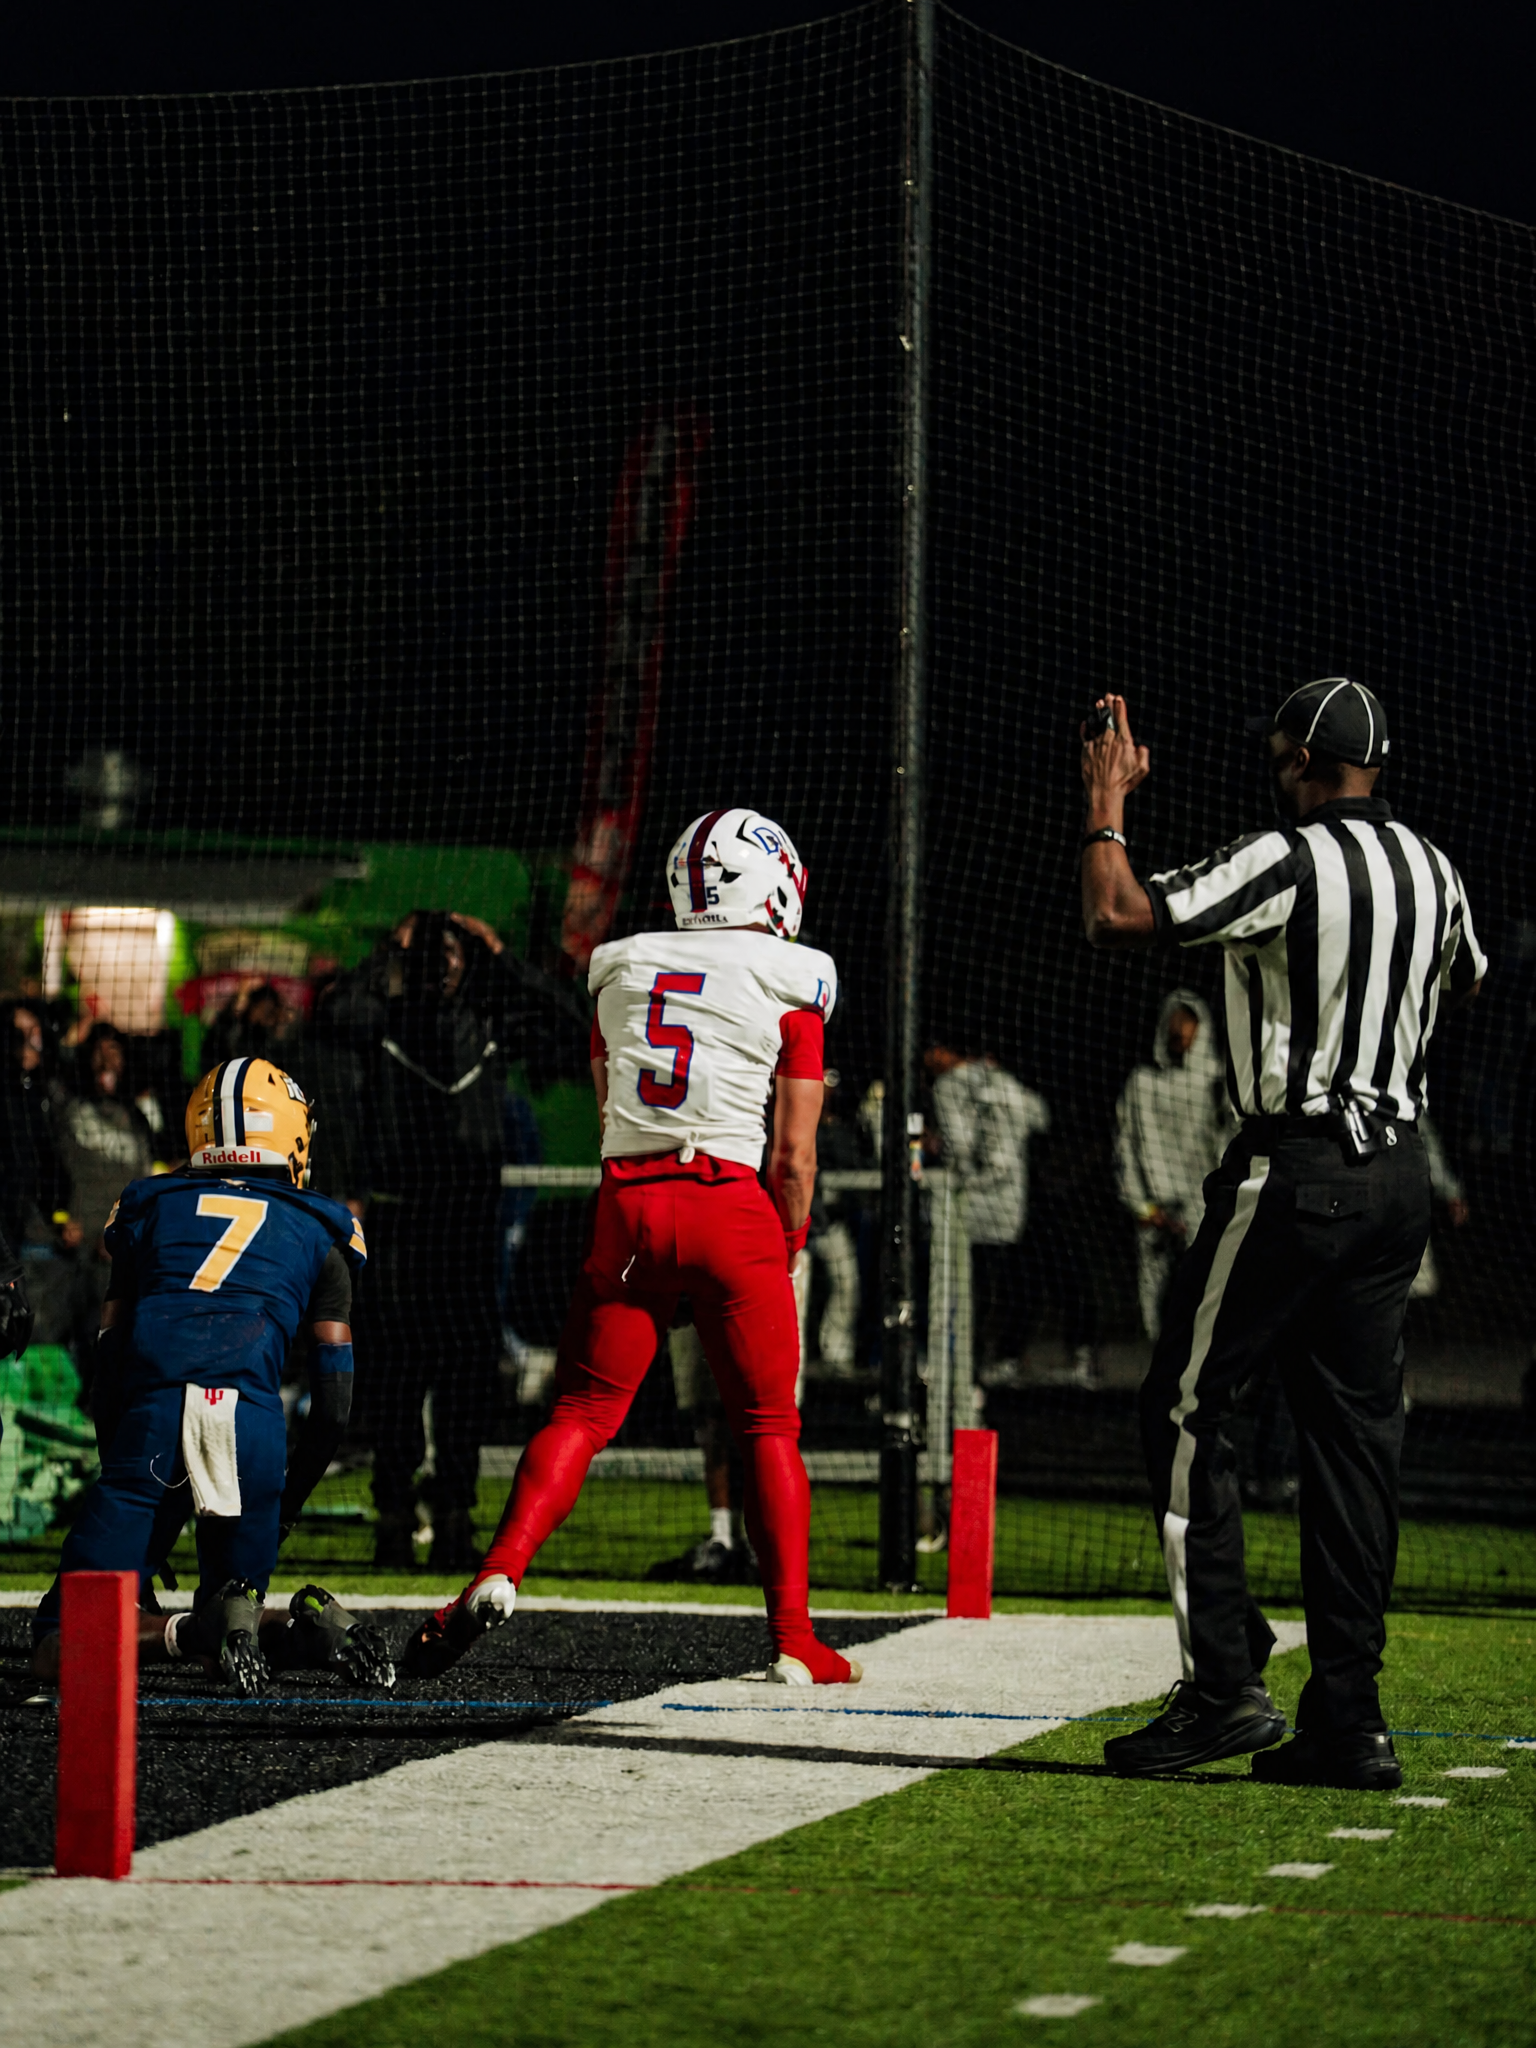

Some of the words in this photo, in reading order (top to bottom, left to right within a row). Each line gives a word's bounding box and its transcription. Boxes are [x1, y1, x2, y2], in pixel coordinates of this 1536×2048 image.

[706, 886, 720, 905] 5
[637, 971, 707, 1111] 5
[202, 1150, 261, 1164] Riddell
[188, 1194, 269, 1293] 7
